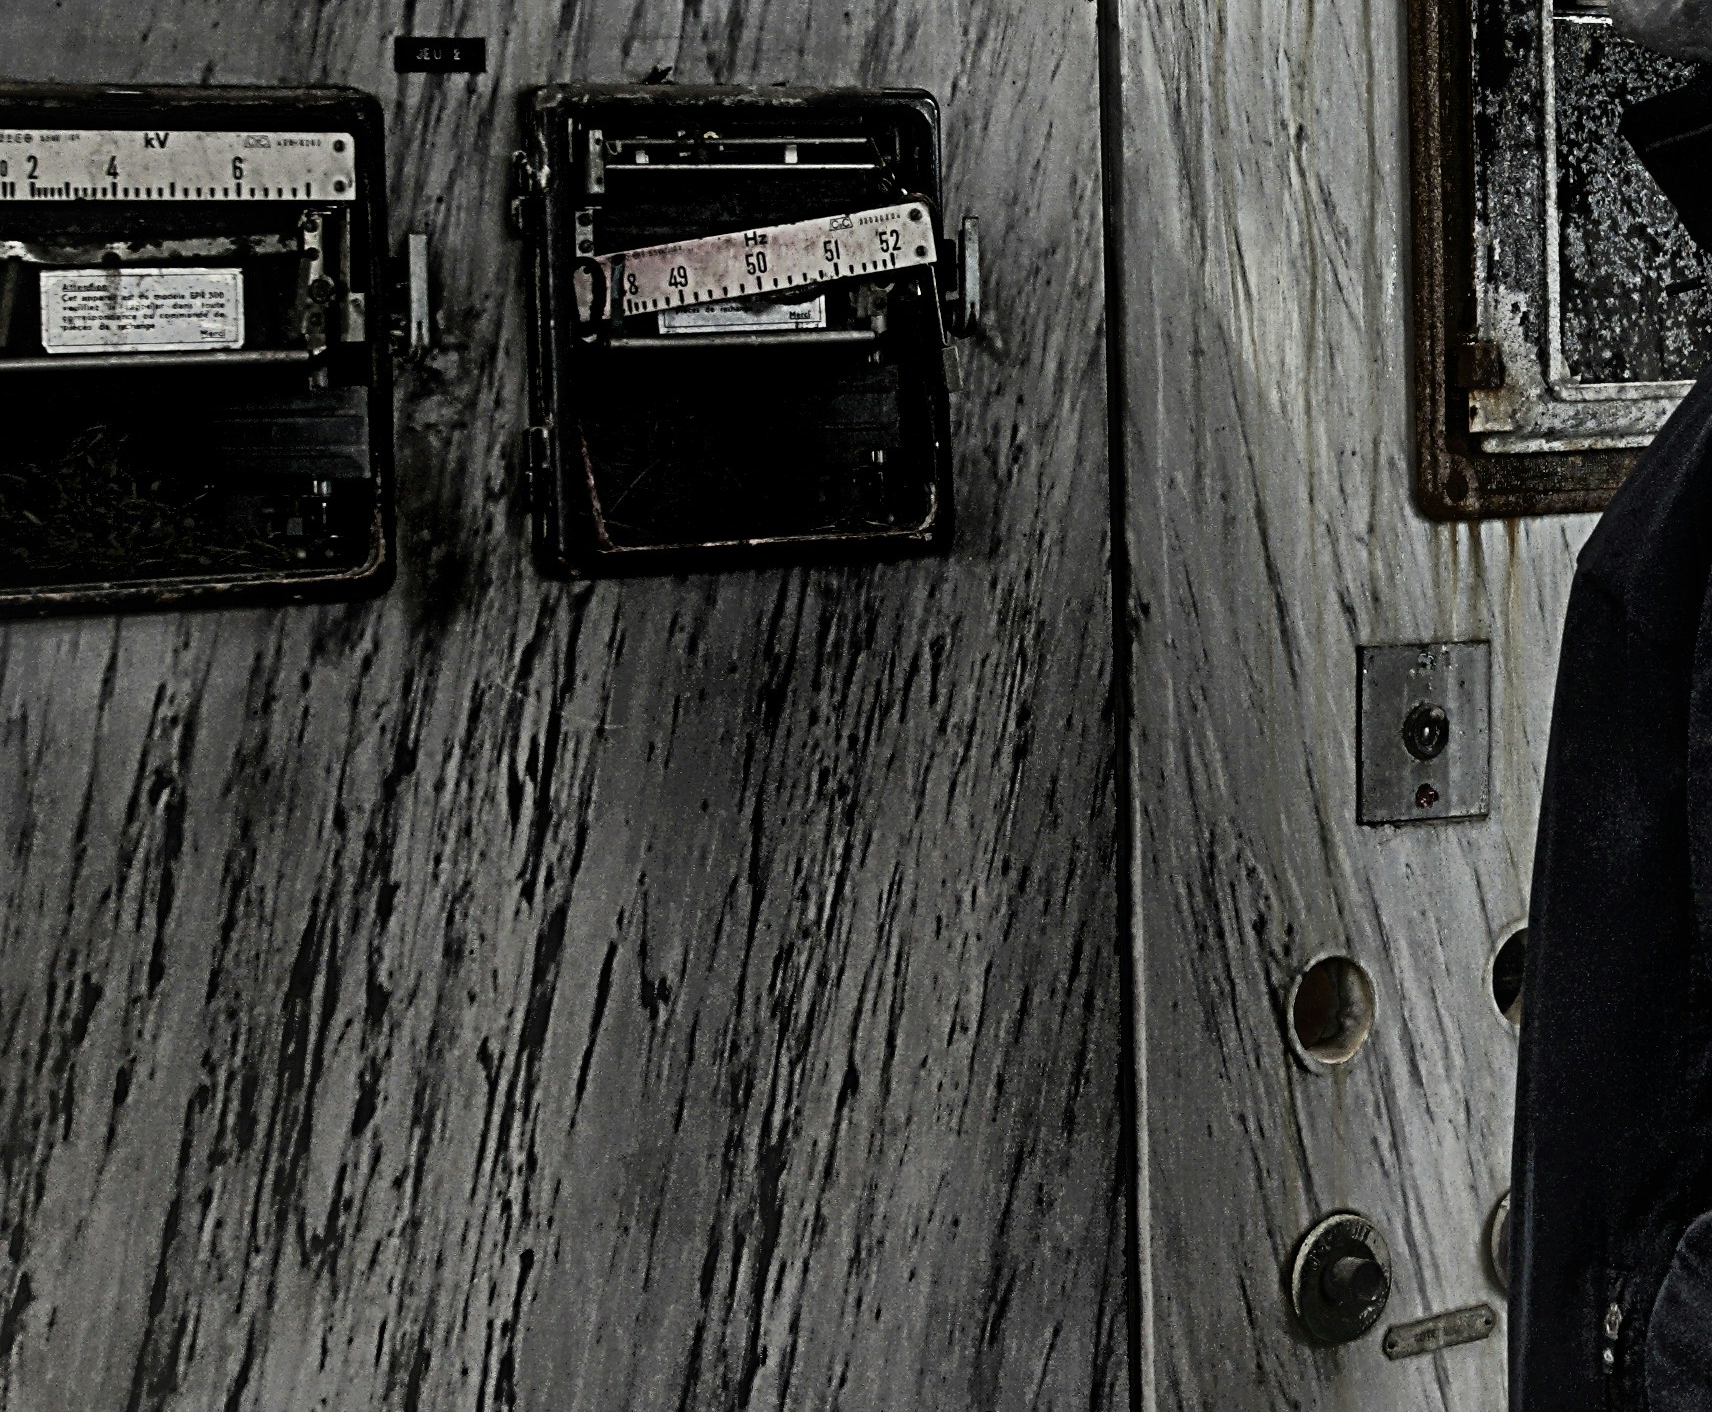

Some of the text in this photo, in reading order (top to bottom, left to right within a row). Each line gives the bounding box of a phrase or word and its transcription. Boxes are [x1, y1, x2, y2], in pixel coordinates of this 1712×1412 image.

[144, 133, 170, 150] kV
[26, 156, 39, 179] 2
[107, 156, 119, 179] 4
[231, 156, 244, 180] 6
[744, 232, 768, 247] Hz
[879, 229, 901, 253] 52
[824, 240, 840, 263] 51
[745, 252, 768, 275] 50
[668, 266, 689, 288] 49
